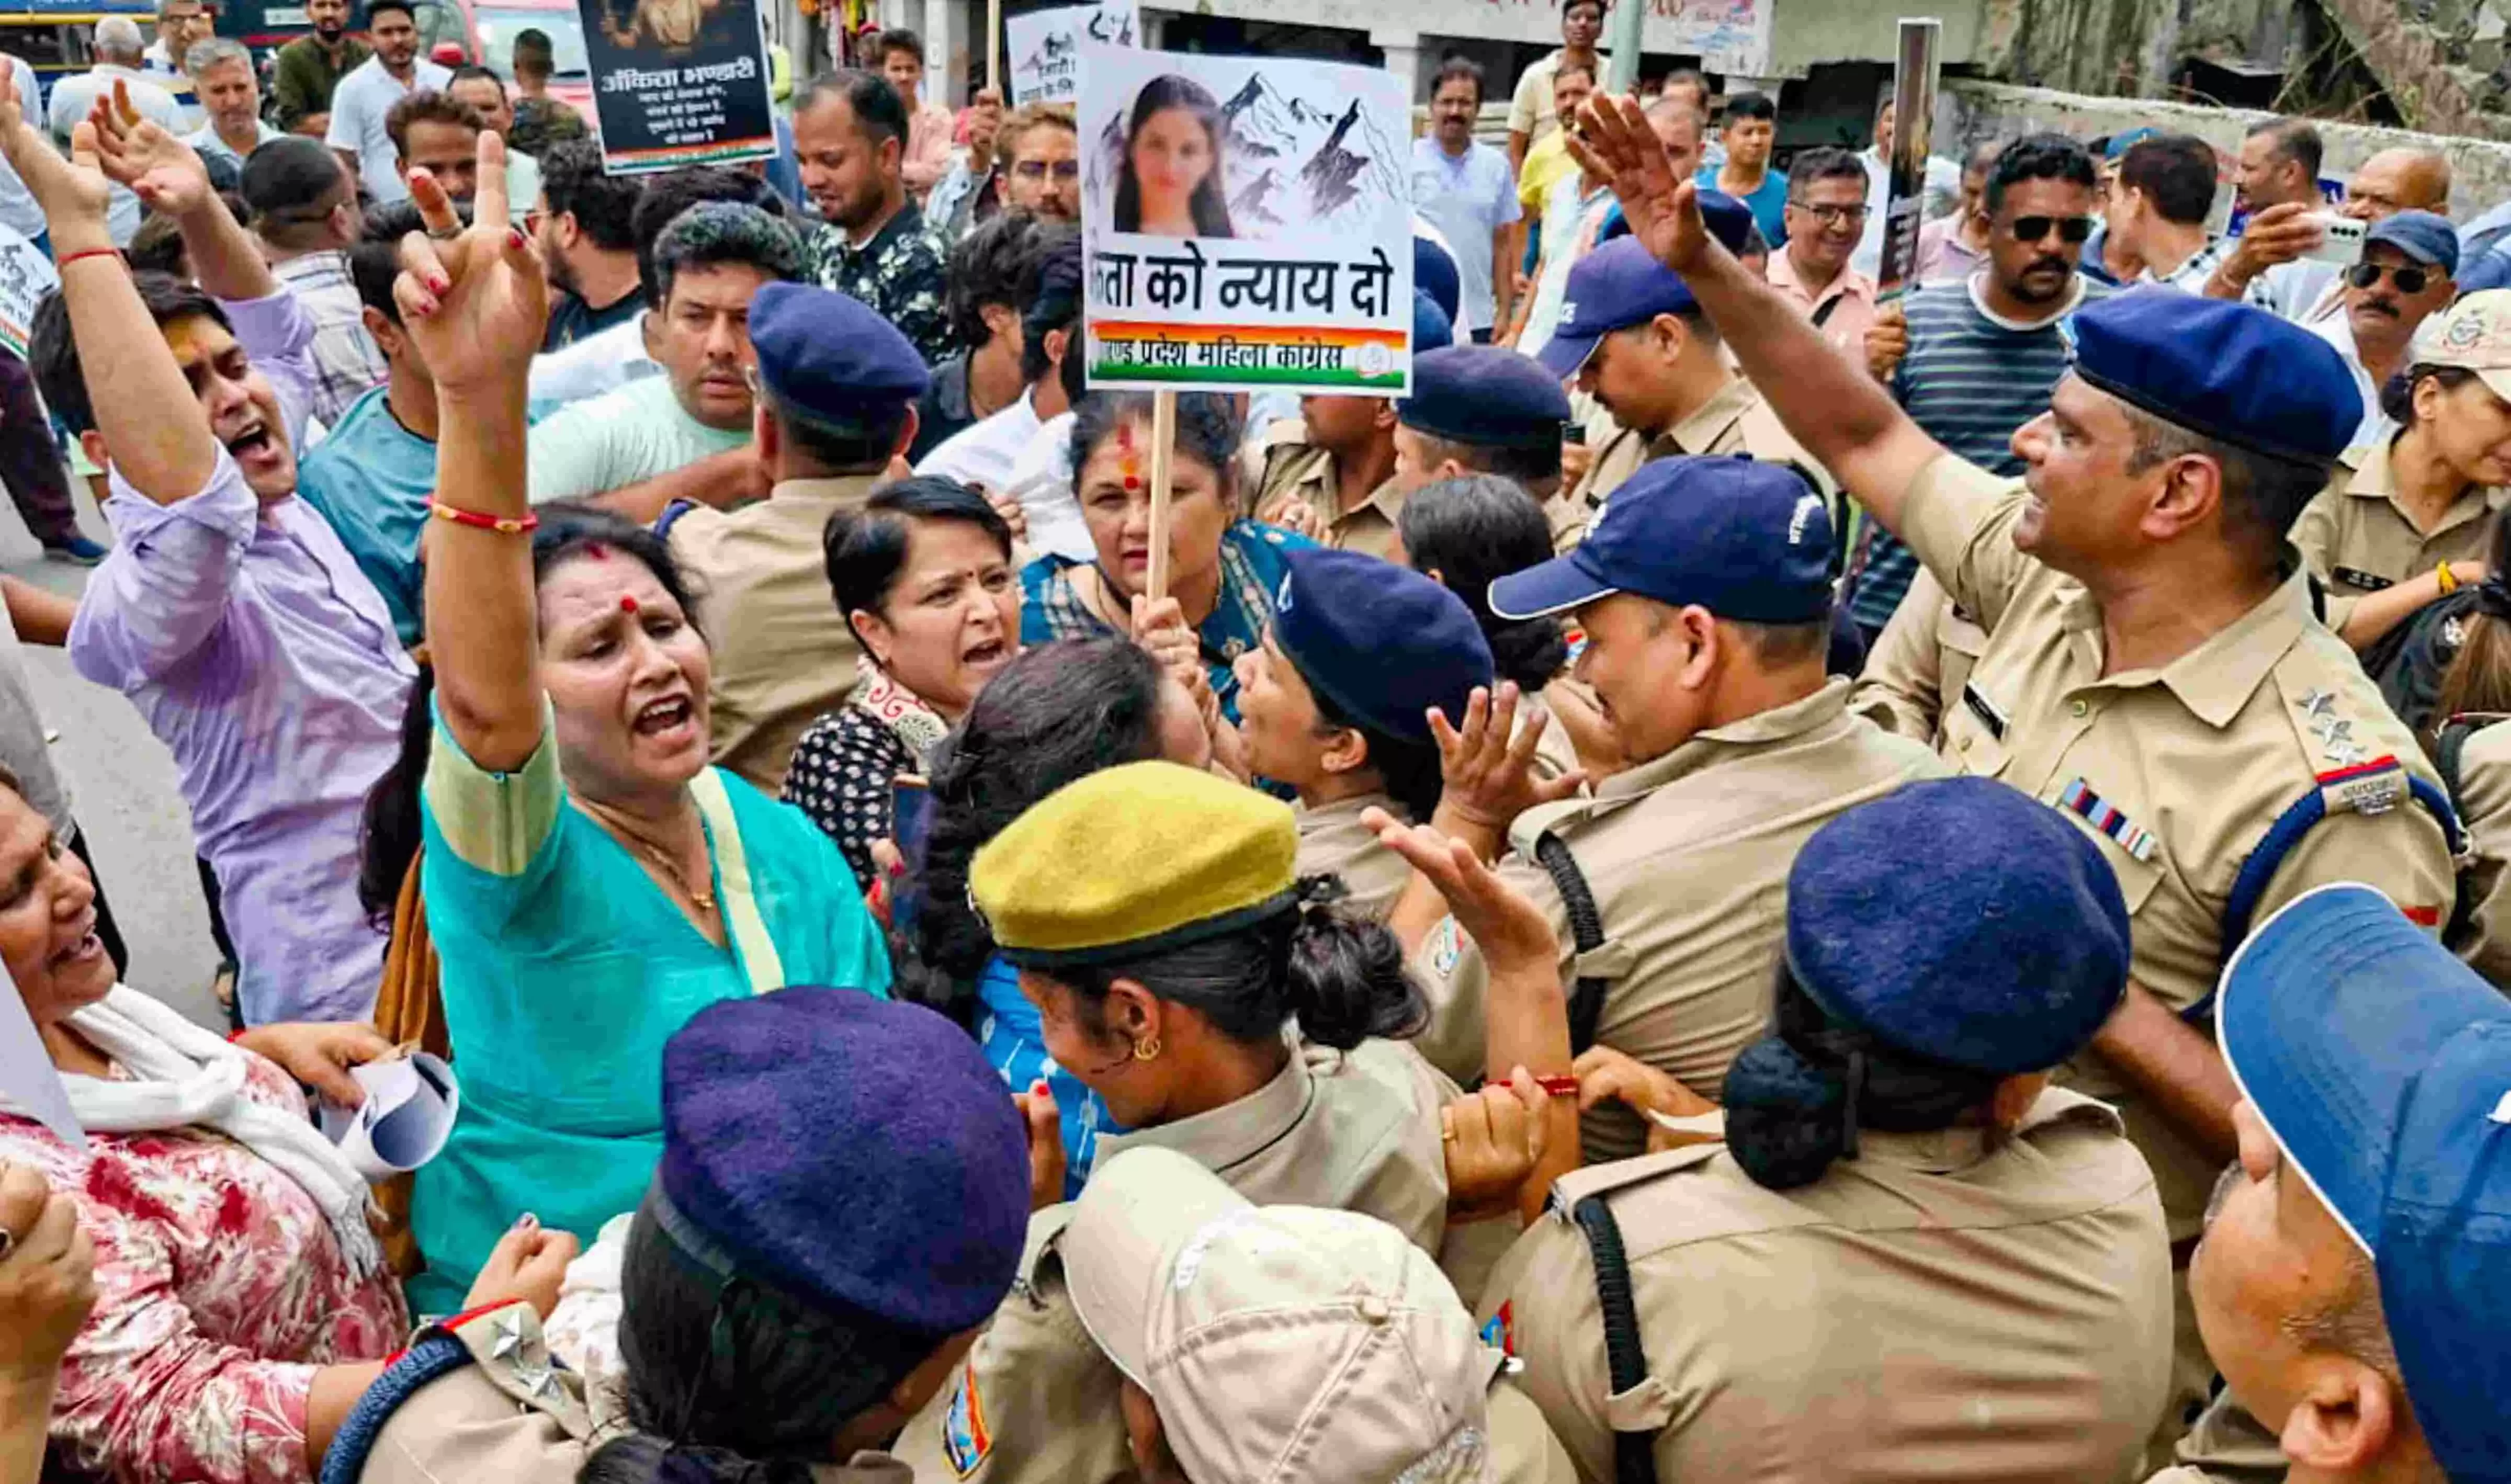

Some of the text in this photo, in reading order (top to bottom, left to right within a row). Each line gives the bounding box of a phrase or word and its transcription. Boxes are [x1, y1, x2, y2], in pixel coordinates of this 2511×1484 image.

[1145, 240, 1207, 310] को
[1217, 258, 1339, 314] न्याय
[1349, 246, 1394, 317] दो
[1140, 332, 1190, 368] प्रदेश
[1196, 334, 1270, 368] महिला
[1275, 336, 1346, 371] कांग्रेस
